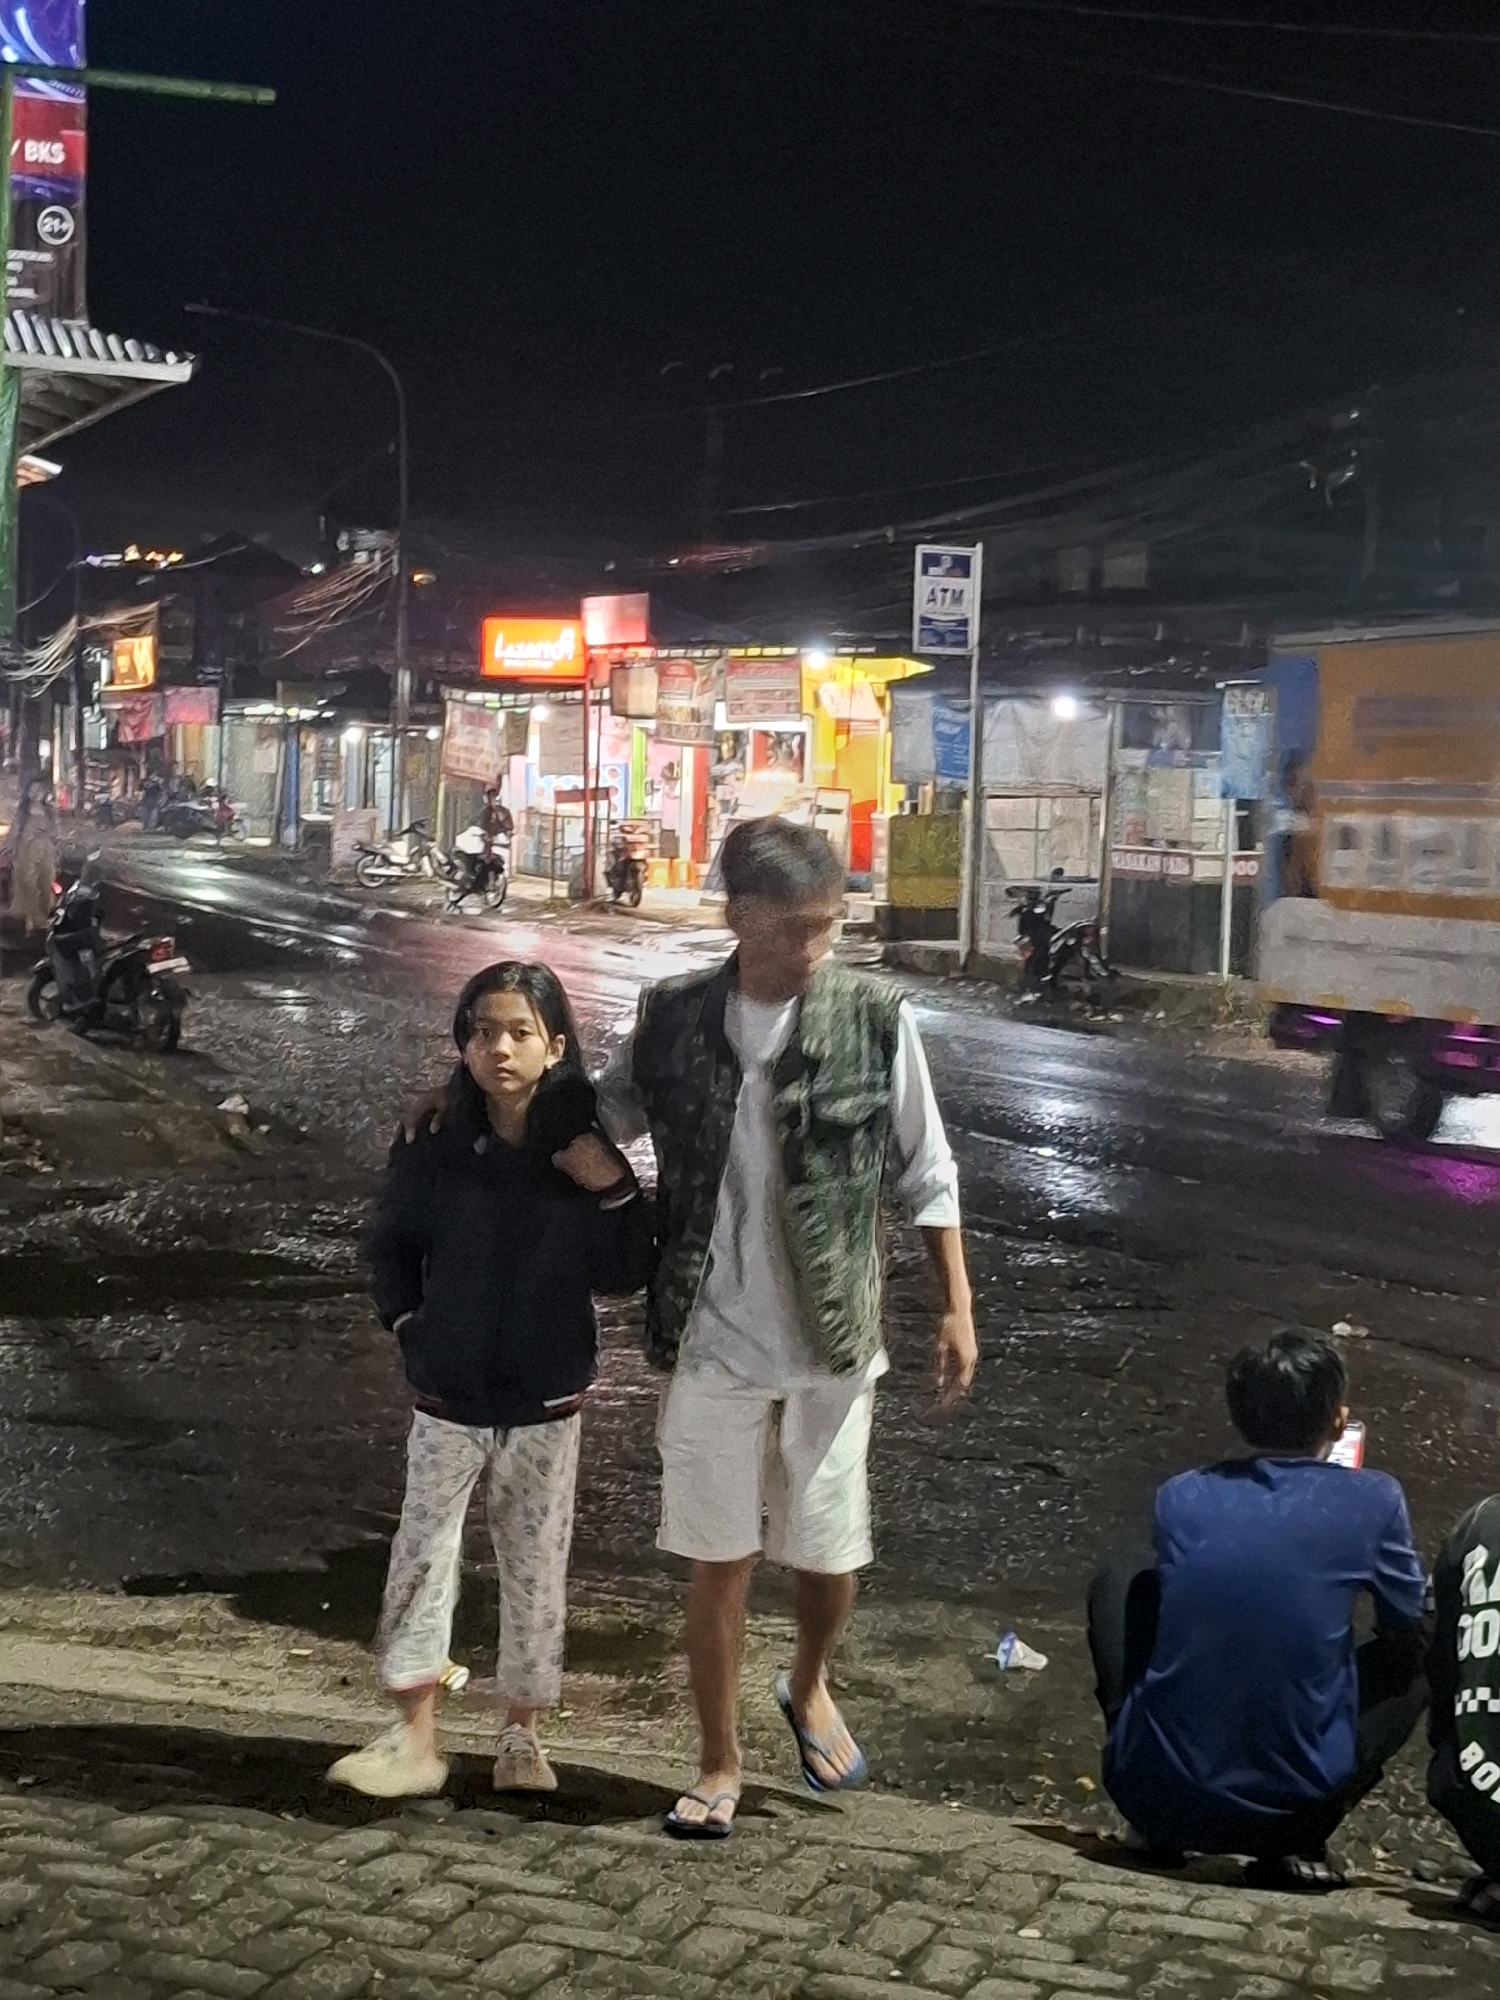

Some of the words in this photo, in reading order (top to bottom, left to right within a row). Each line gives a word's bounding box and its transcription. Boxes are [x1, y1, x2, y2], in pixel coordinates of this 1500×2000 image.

[24, 139, 66, 165] BKS
[925, 586, 965, 608] ATM
[1459, 1740, 1500, 1804] BO
